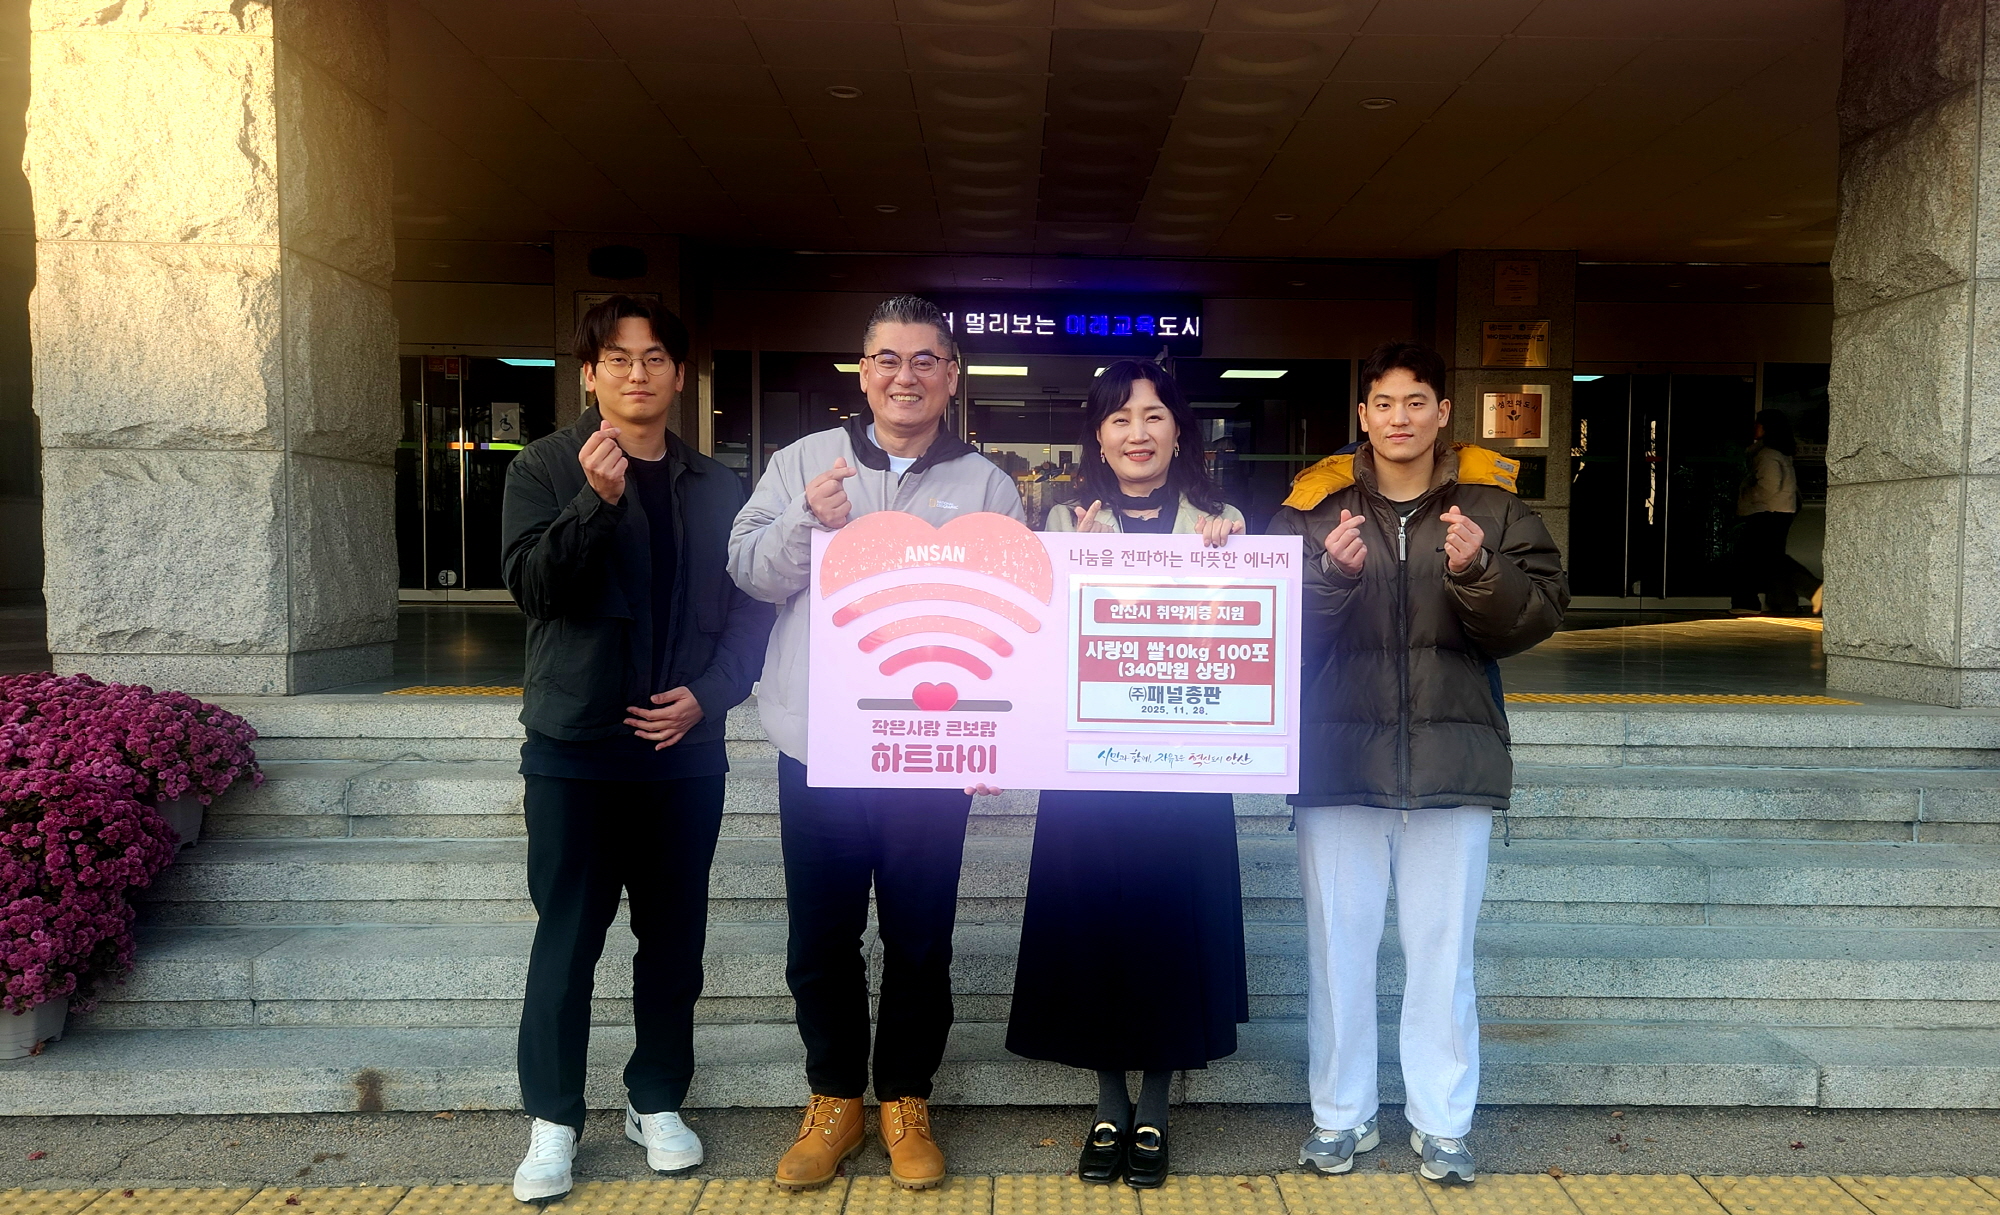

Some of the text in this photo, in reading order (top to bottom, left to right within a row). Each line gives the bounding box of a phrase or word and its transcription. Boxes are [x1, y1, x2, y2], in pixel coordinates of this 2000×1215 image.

[965, 312, 1056, 335] 멀리보는
[904, 545, 966, 563] ANSAN
[1069, 549, 1289, 569] 나눔을 전파하는 따뜻한 에너지
[1110, 604, 1244, 621] 안산시 취약계층 지원
[1085, 641, 1270, 663] 사랑의 쌀10kg 100포
[1118, 662, 1236, 681] (340만원 상당)
[1141, 705, 1208, 715] 2025. 11. 28.
[871, 719, 997, 738] 작은사랑 큰보람
[871, 742, 997, 775] 하트파이
[1097, 747, 1129, 767] 시민과
[1154, 752, 1185, 769] 자유로운
[1188, 752, 1223, 768] 혁신도시
[1225, 752, 1254, 766] 안산
